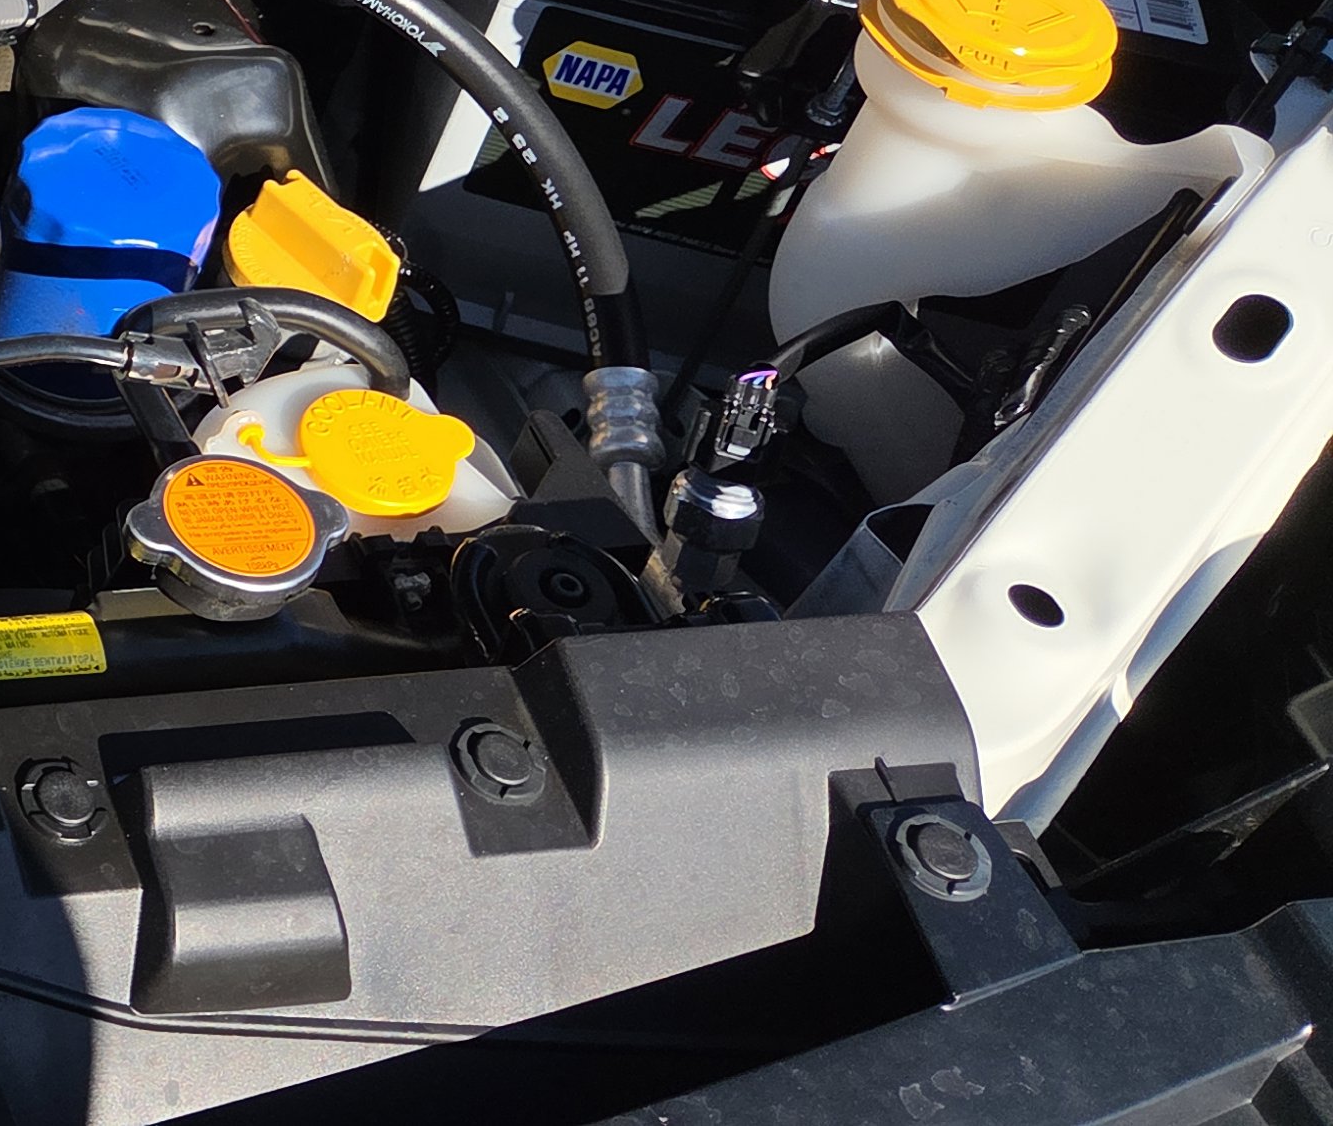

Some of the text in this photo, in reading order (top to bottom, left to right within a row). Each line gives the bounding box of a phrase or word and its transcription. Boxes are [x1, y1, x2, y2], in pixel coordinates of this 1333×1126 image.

[958, 45, 1017, 74] PULL
[554, 54, 631, 96] NAPA
[492, 106, 509, 124] 2
[539, 177, 564, 211] HK
[563, 230, 582, 261] HP
[306, 390, 416, 437] COOLANT
[203, 471, 259, 482] WARNING
[212, 542, 296, 556] AVERTISSEMENT
